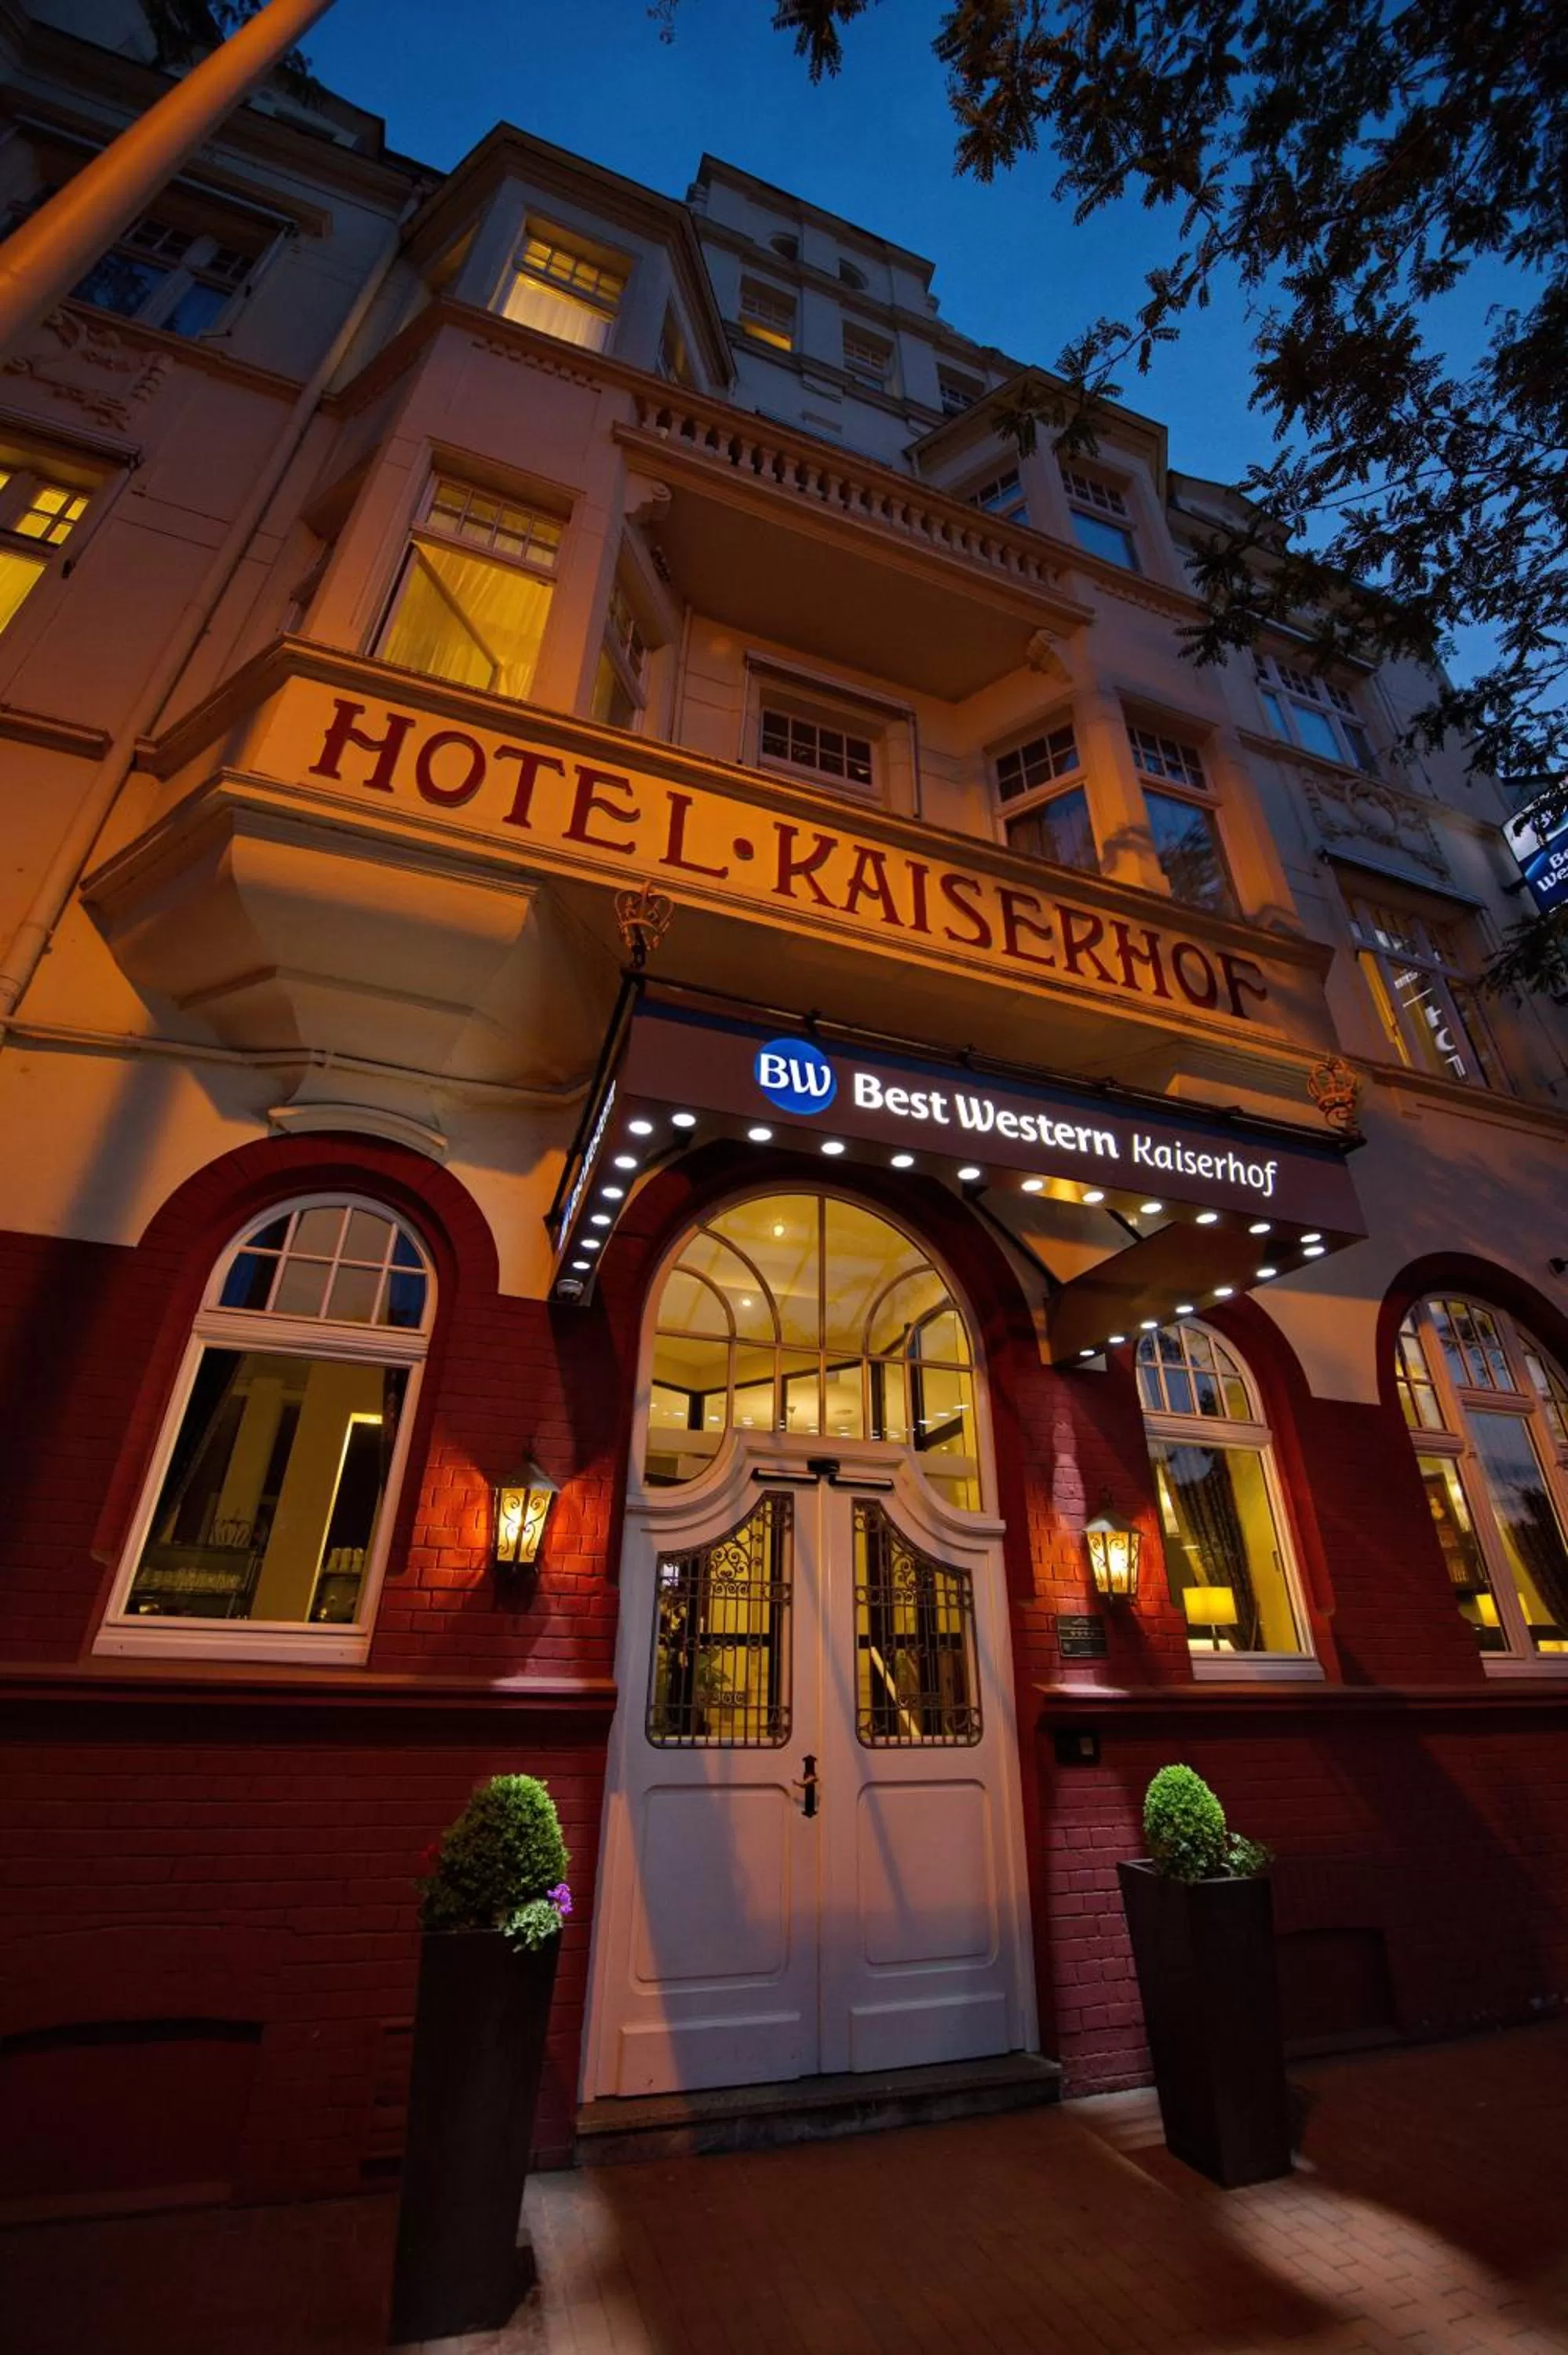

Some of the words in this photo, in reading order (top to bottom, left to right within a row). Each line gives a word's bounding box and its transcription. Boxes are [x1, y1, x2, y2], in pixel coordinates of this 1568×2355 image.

[308, 698, 729, 880] HOTEL
[772, 821, 1267, 1020] KAISERHOF
[759, 1053, 832, 1097] BW
[853, 1072, 950, 1125] Best
[954, 1093, 1121, 1160] Western
[1132, 1133, 1278, 1198] Kaiserhof
